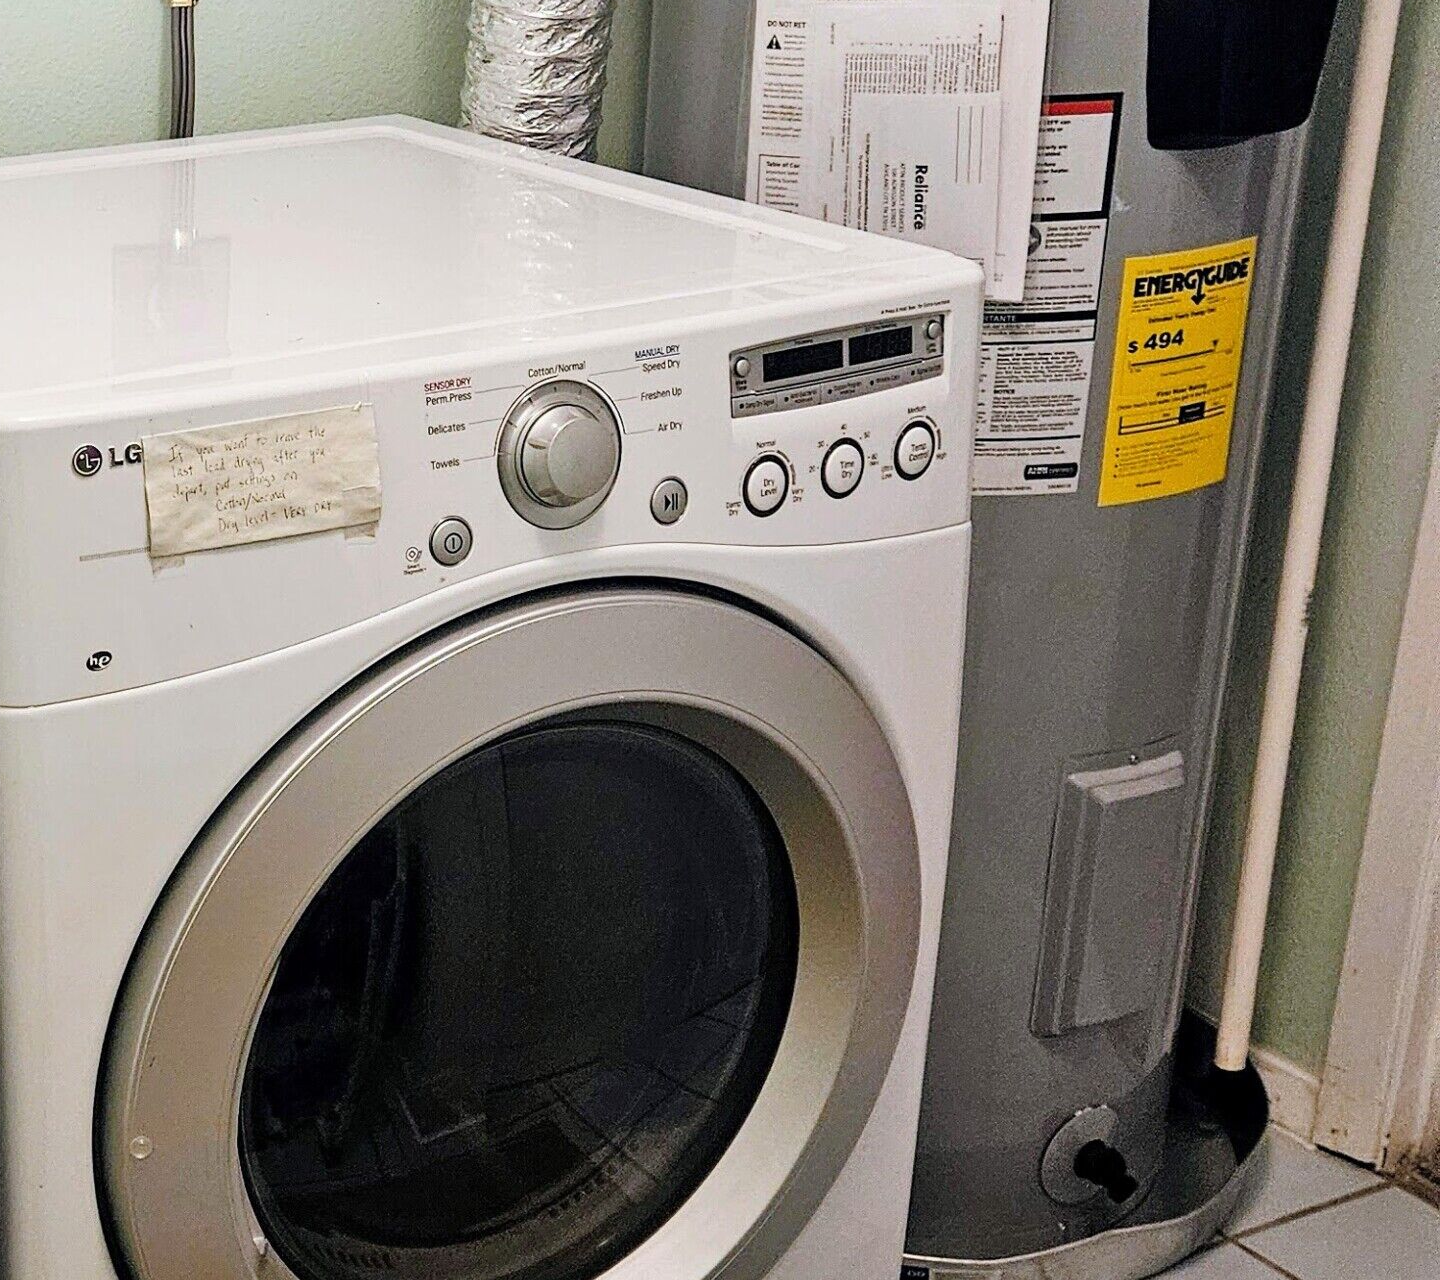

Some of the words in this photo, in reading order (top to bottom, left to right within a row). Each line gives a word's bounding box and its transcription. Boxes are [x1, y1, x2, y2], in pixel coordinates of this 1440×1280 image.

[767, 20, 778, 28] DO
[779, 20, 793, 28] NOT
[914, 164, 929, 231] Reliance
[1133, 257, 1250, 298] ENERGYGUIDE
[1143, 329, 1185, 351] 494
[635, 347, 664, 360] MANUAL
[665, 344, 681, 355] DRY
[528, 361, 586, 379] Cotton/Normal
[642, 360, 667, 374] Speed
[667, 358, 681, 370] Dry
[424, 379, 453, 392] SENSOR
[454, 376, 472, 388] DRY
[640, 387, 672, 402] Freshen
[672, 386, 682, 398] Up
[427, 422, 467, 436] Delicates
[658, 422, 669, 432] Air
[670, 420, 683, 433] Dry
[168, 443, 183, 465] If
[196, 446, 216, 462] you
[224, 436, 249, 453] want
[257, 434, 268, 447] to
[274, 430, 303, 446] leave
[308, 426, 326, 439] the
[109, 443, 142, 467] LG
[172, 463, 194, 477] last
[205, 458, 226, 473] load
[233, 454, 266, 475] drying
[274, 449, 298, 468] after
[309, 448, 326, 465] you
[909, 452, 930, 462] Control
[431, 458, 461, 471] Towels
[841, 469, 853, 479] Dry
[214, 479, 231, 496] put
[238, 473, 277, 493] settings
[284, 470, 298, 483] on
[763, 478, 775, 488] Dry
[761, 487, 778, 497] Level
[215, 490, 288, 513] Cotton/Normal
[218, 516, 240, 534] Dry
[314, 501, 333, 515] DRY
[86, 651, 112, 671] he
